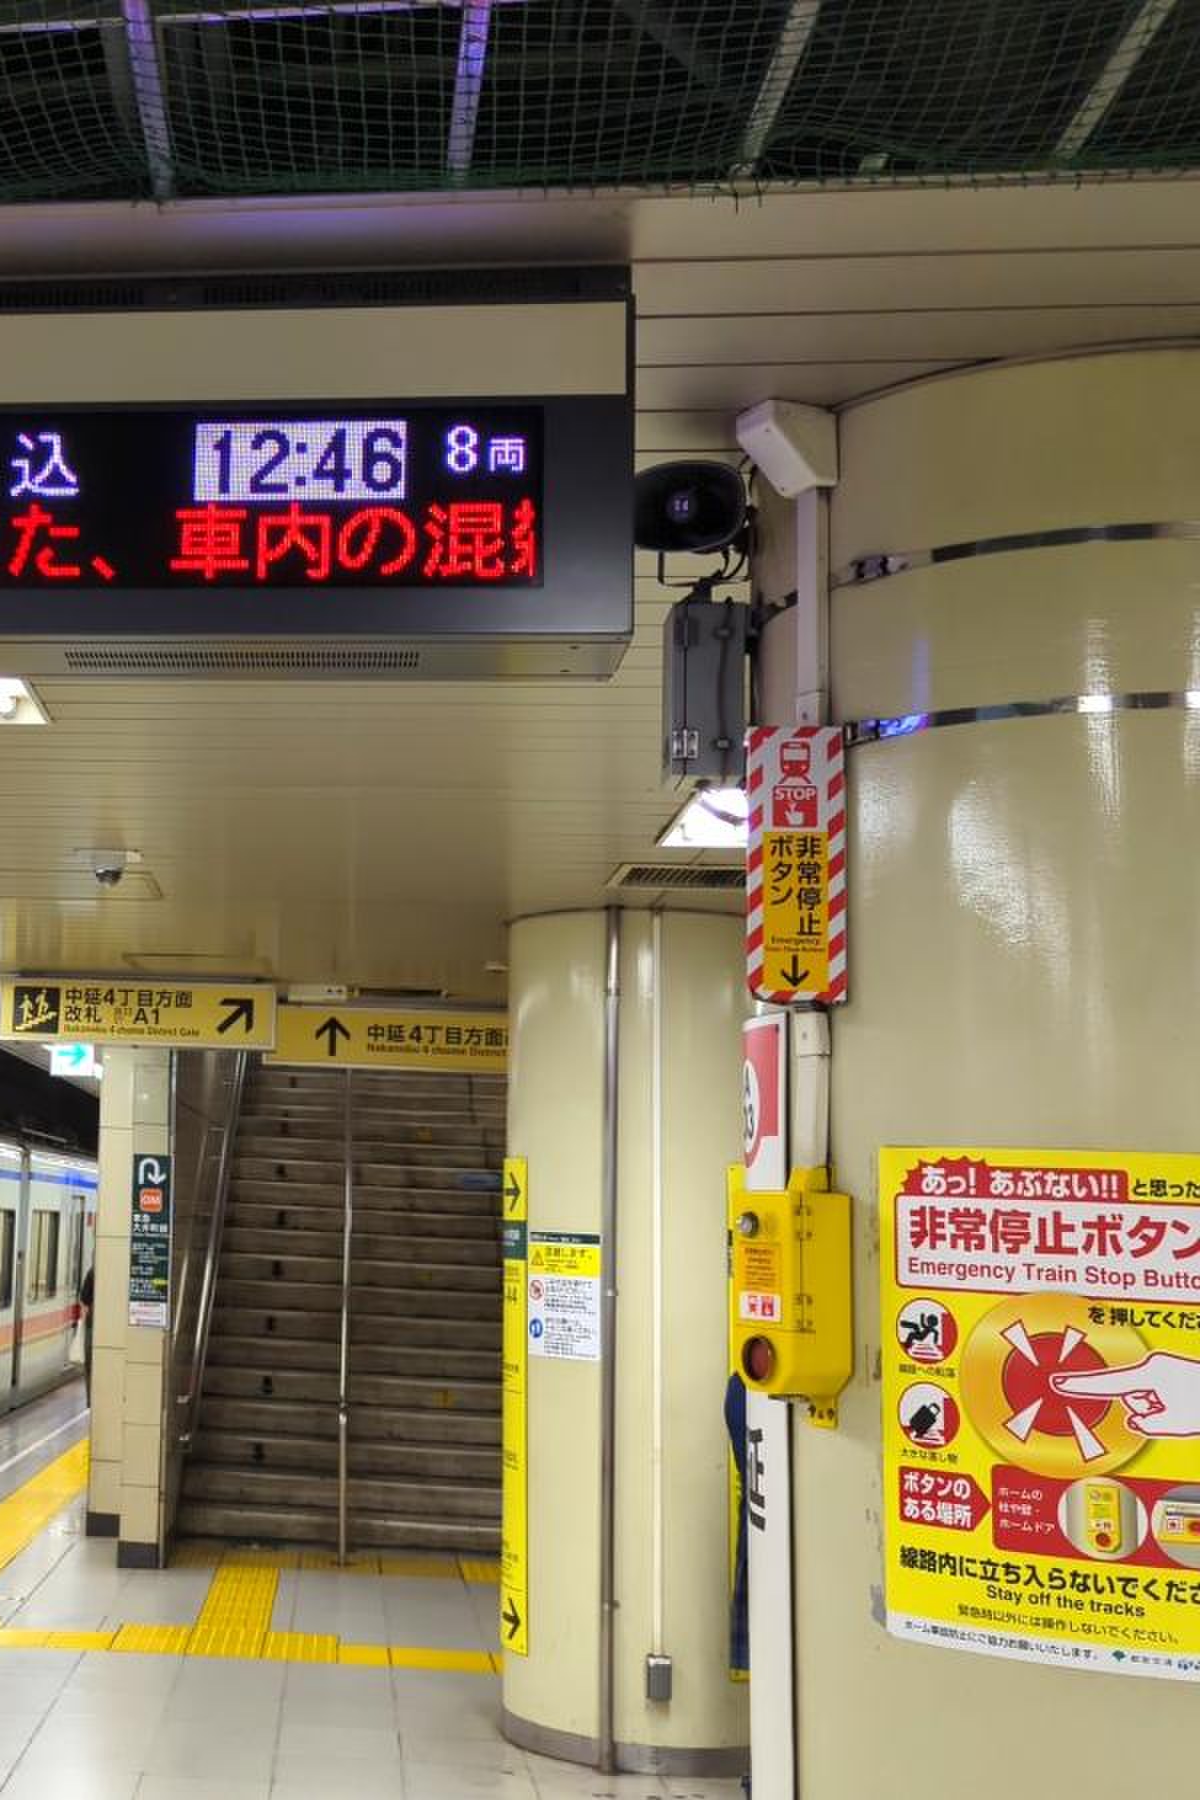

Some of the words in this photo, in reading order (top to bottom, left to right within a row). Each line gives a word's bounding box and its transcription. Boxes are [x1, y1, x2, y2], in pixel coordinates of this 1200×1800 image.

[212, 426, 404, 496] 12:46
[775, 787, 817, 801] STOP
[770, 834, 794, 906] ボタン
[796, 835, 822, 938] 非常停止
[65, 987, 194, 1009] 中延4丁目方面
[65, 1006, 103, 1024] 改札
[133, 1007, 161, 1025] A1
[368, 1023, 510, 1047] 中延4丁目方面
[909, 1206, 1200, 1260] 非常停止ボタン
[909, 1257, 1017, 1283] Emergency
[1023, 1263, 1078, 1283] Train
[1085, 1266, 1137, 1290] Stop
[903, 1471, 971, 1500] ボタンの
[903, 1498, 973, 1529] ある場所
[986, 1585, 1023, 1606] Stay
[1029, 1591, 1051, 1607] off
[1057, 1594, 1085, 1612] the
[1089, 1599, 1146, 1618] tracks
